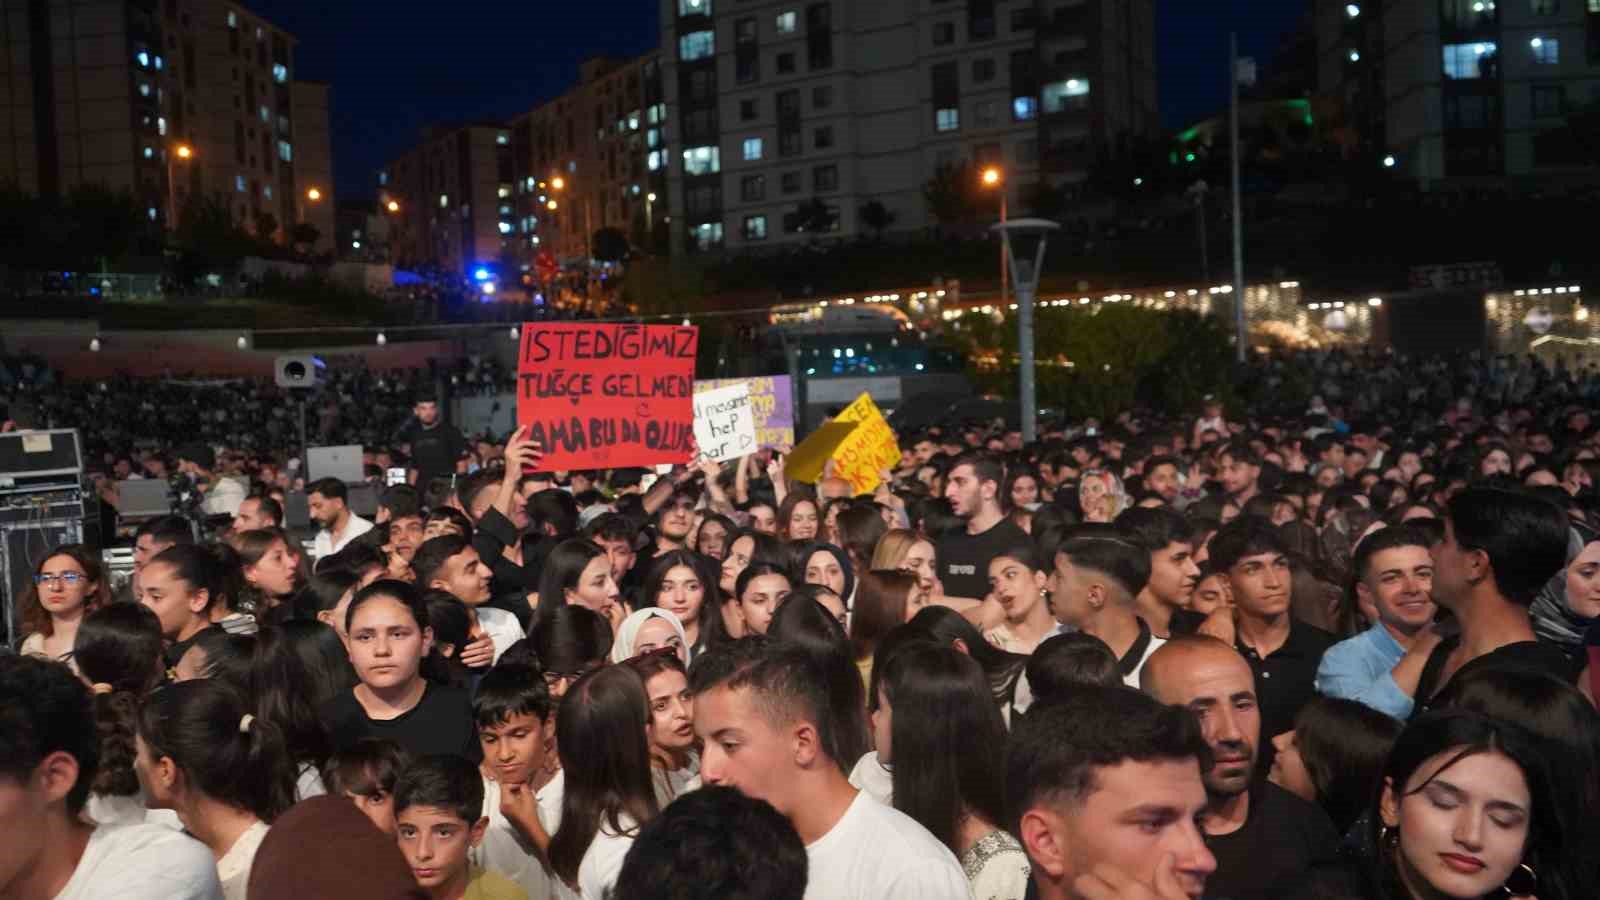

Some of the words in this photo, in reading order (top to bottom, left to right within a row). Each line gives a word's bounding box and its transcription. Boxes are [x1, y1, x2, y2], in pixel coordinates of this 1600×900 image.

[520, 369, 593, 405] TUĞÇE
[530, 417, 586, 454] AMA
[589, 418, 616, 448] BU
